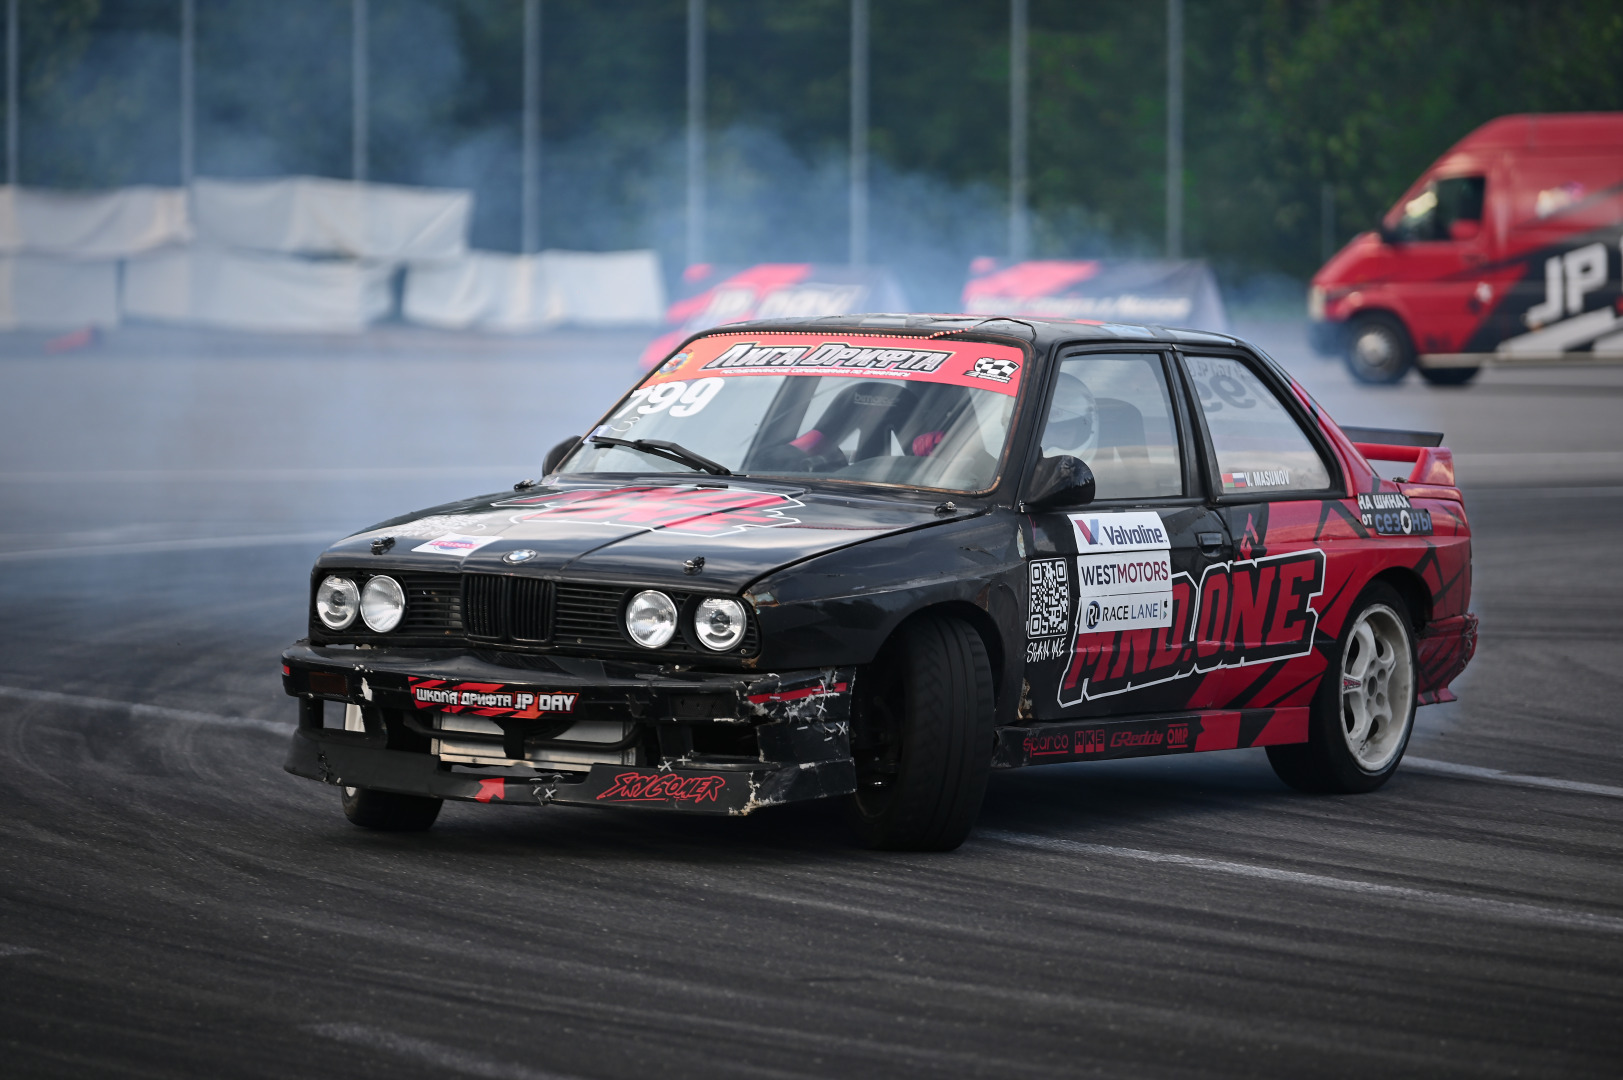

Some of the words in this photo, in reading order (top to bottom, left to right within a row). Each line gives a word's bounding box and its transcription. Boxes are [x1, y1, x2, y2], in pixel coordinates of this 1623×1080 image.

[1526, 242, 1608, 328] JP
[614, 377, 725, 418] 799
[1253, 470, 1290, 486] MASUNOV
[1358, 494, 1373, 510] НА
[1372, 494, 1410, 510] ШИНАХ
[1103, 524, 1163, 546] Valvoline
[1081, 560, 1168, 586] WESTMOTORS
[1102, 605, 1129, 622] RACE
[1131, 603, 1159, 620] LANE
[1050, 637, 1067, 660] ME
[415, 688, 458, 705] ШКОЛА
[460, 692, 512, 707] ДРИФТА
[514, 693, 534, 710] JP
[539, 694, 576, 712] DAY
[1022, 734, 1069, 758] sparco
[1075, 729, 1105, 753] HKS
[1166, 727, 1189, 745] OMP
